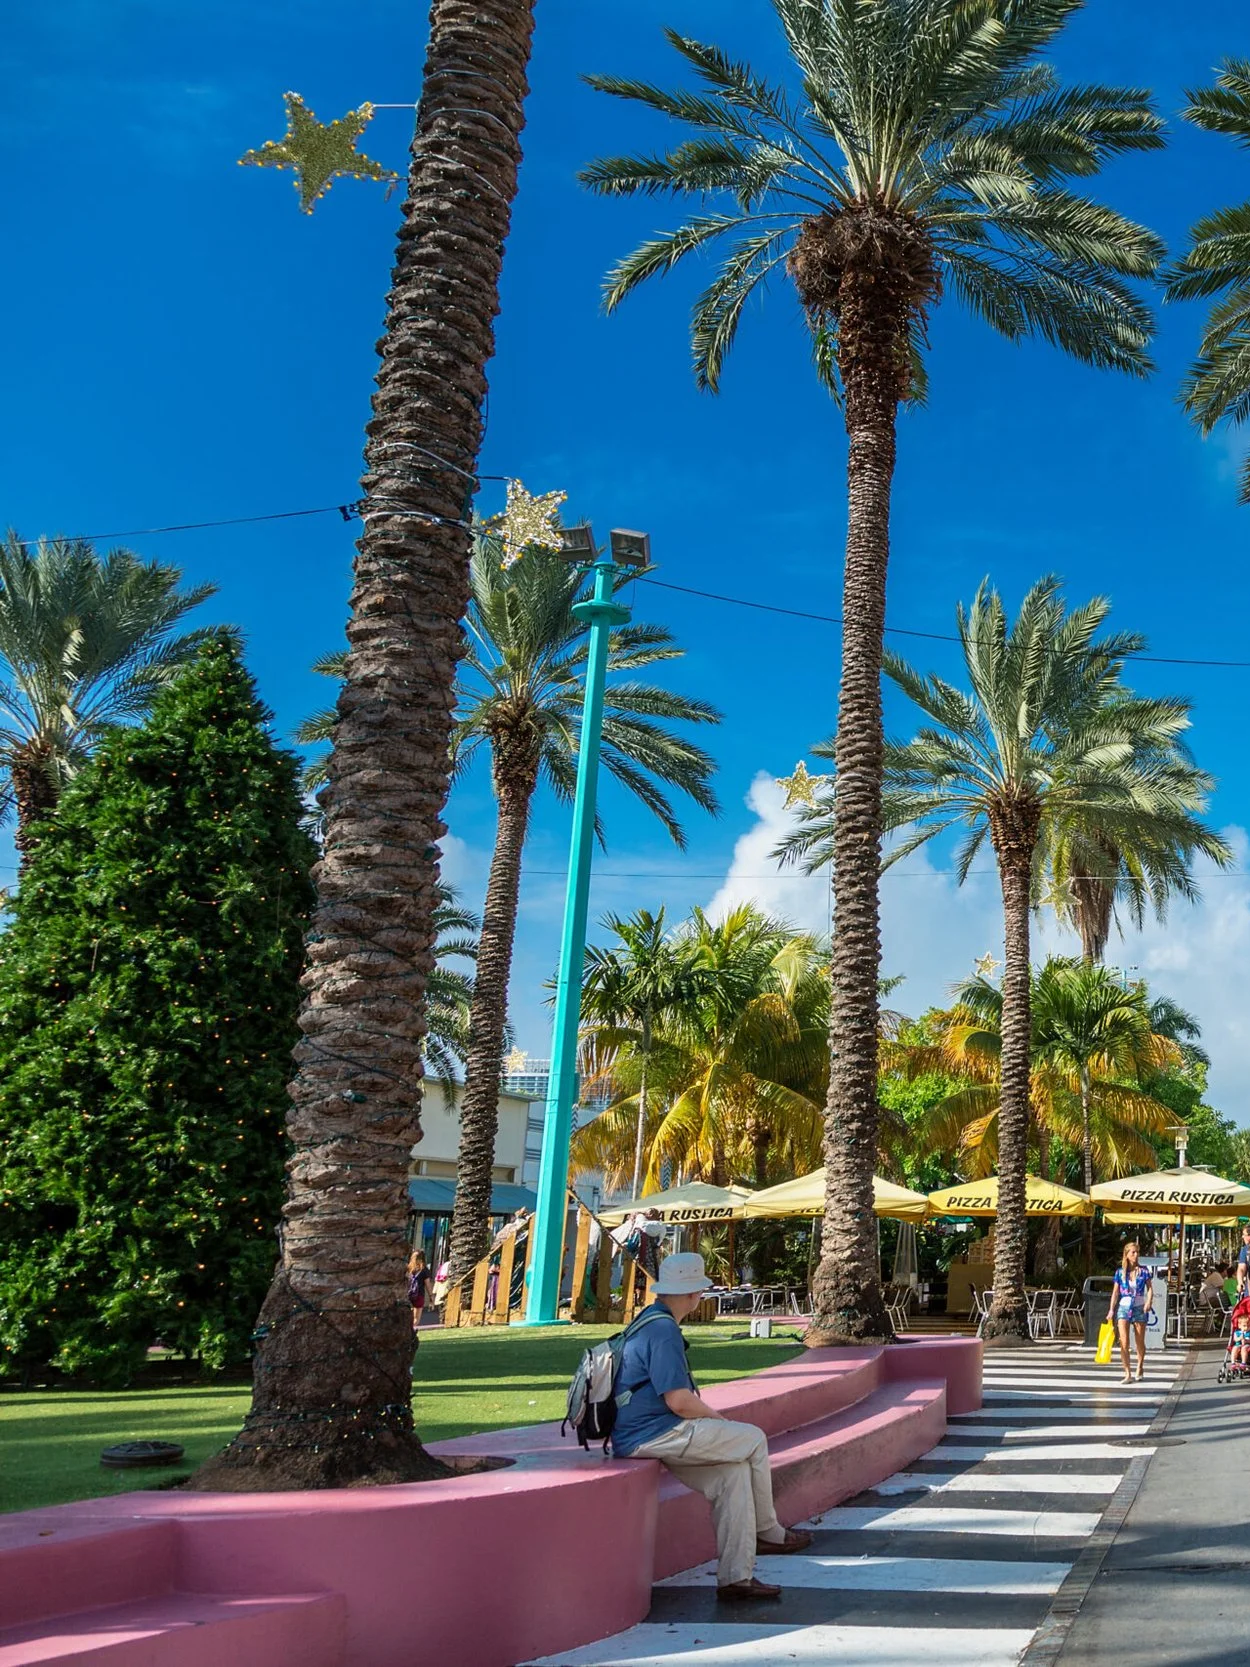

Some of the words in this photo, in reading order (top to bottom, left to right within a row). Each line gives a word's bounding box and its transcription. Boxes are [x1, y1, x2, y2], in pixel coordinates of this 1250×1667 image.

[946, 1196, 992, 1208] PIZZA
[1120, 1189, 1165, 1202] PIZZA
[1168, 1191, 1235, 1205] RUSTICA
[669, 1207, 734, 1221] RUSTICA
